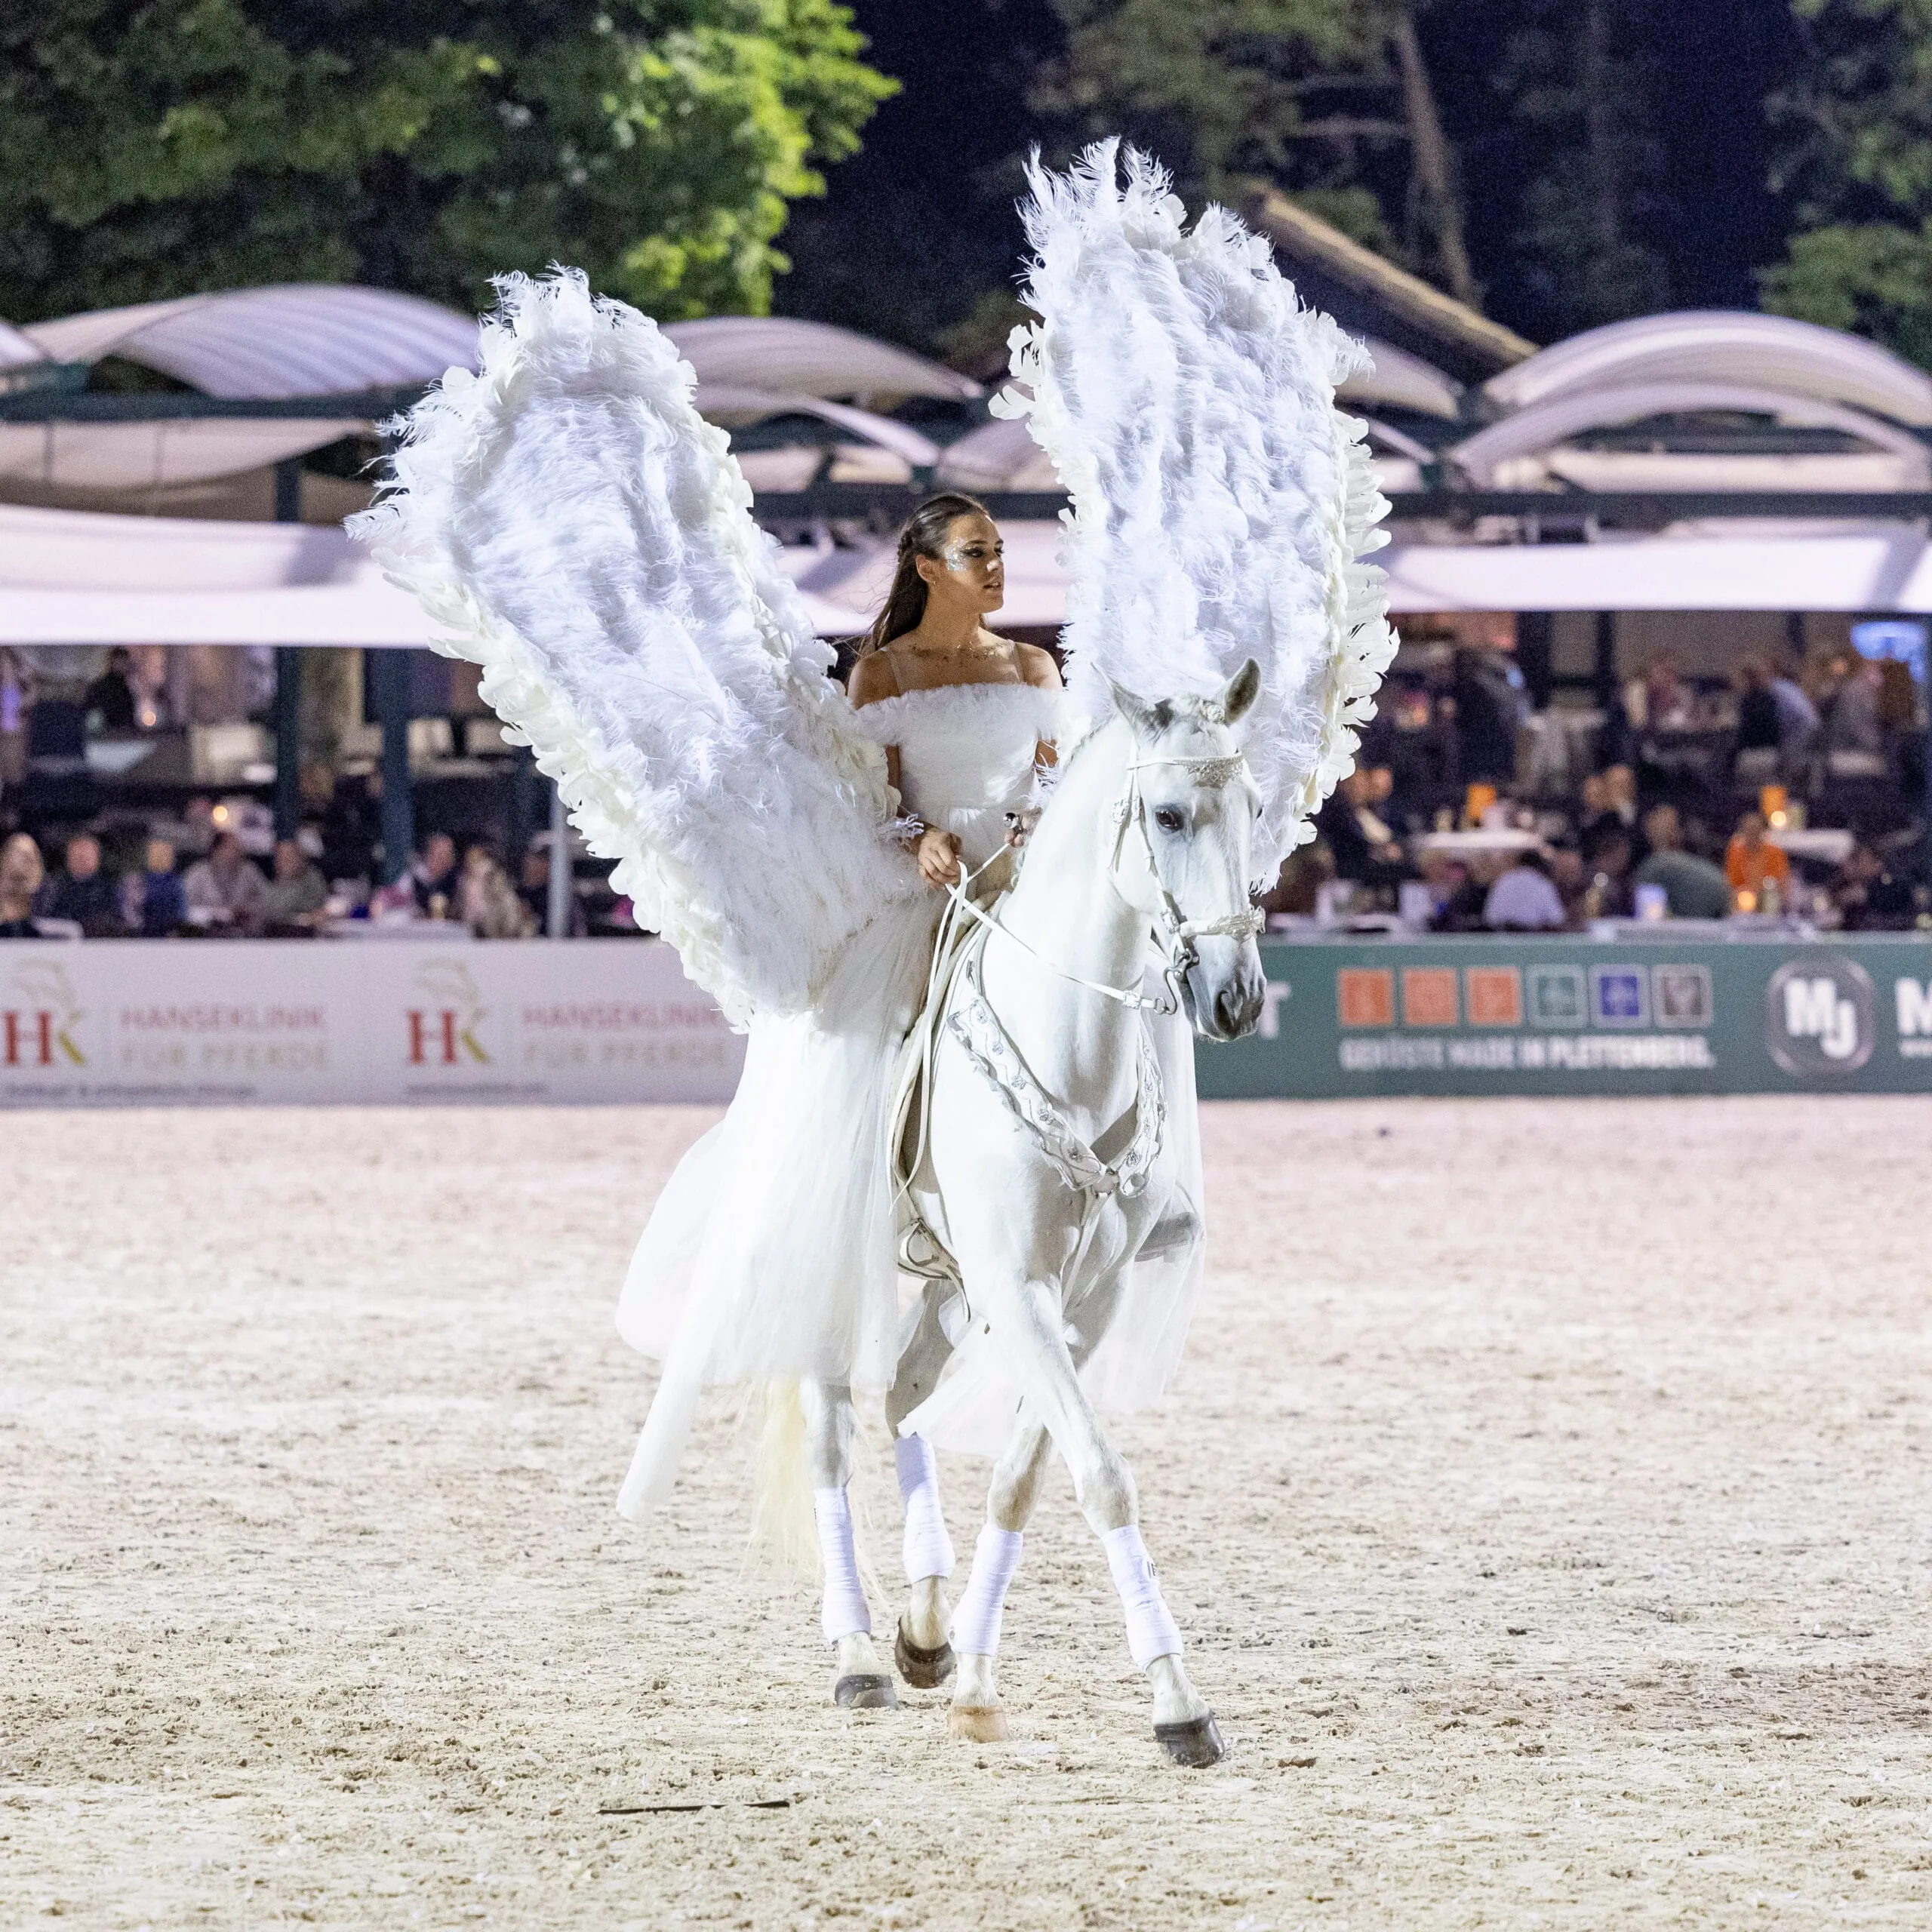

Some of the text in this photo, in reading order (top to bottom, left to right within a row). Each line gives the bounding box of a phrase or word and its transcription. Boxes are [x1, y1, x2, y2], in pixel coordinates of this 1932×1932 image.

[121, 1005, 325, 1030] HANSEKLINIK
[1784, 978, 1857, 1058] MJ
[201, 1041, 329, 1071] PFERDE
[604, 1041, 727, 1069] PFERDE
[1448, 1037, 1514, 1069] MADE
[1517, 1037, 1546, 1069] IN
